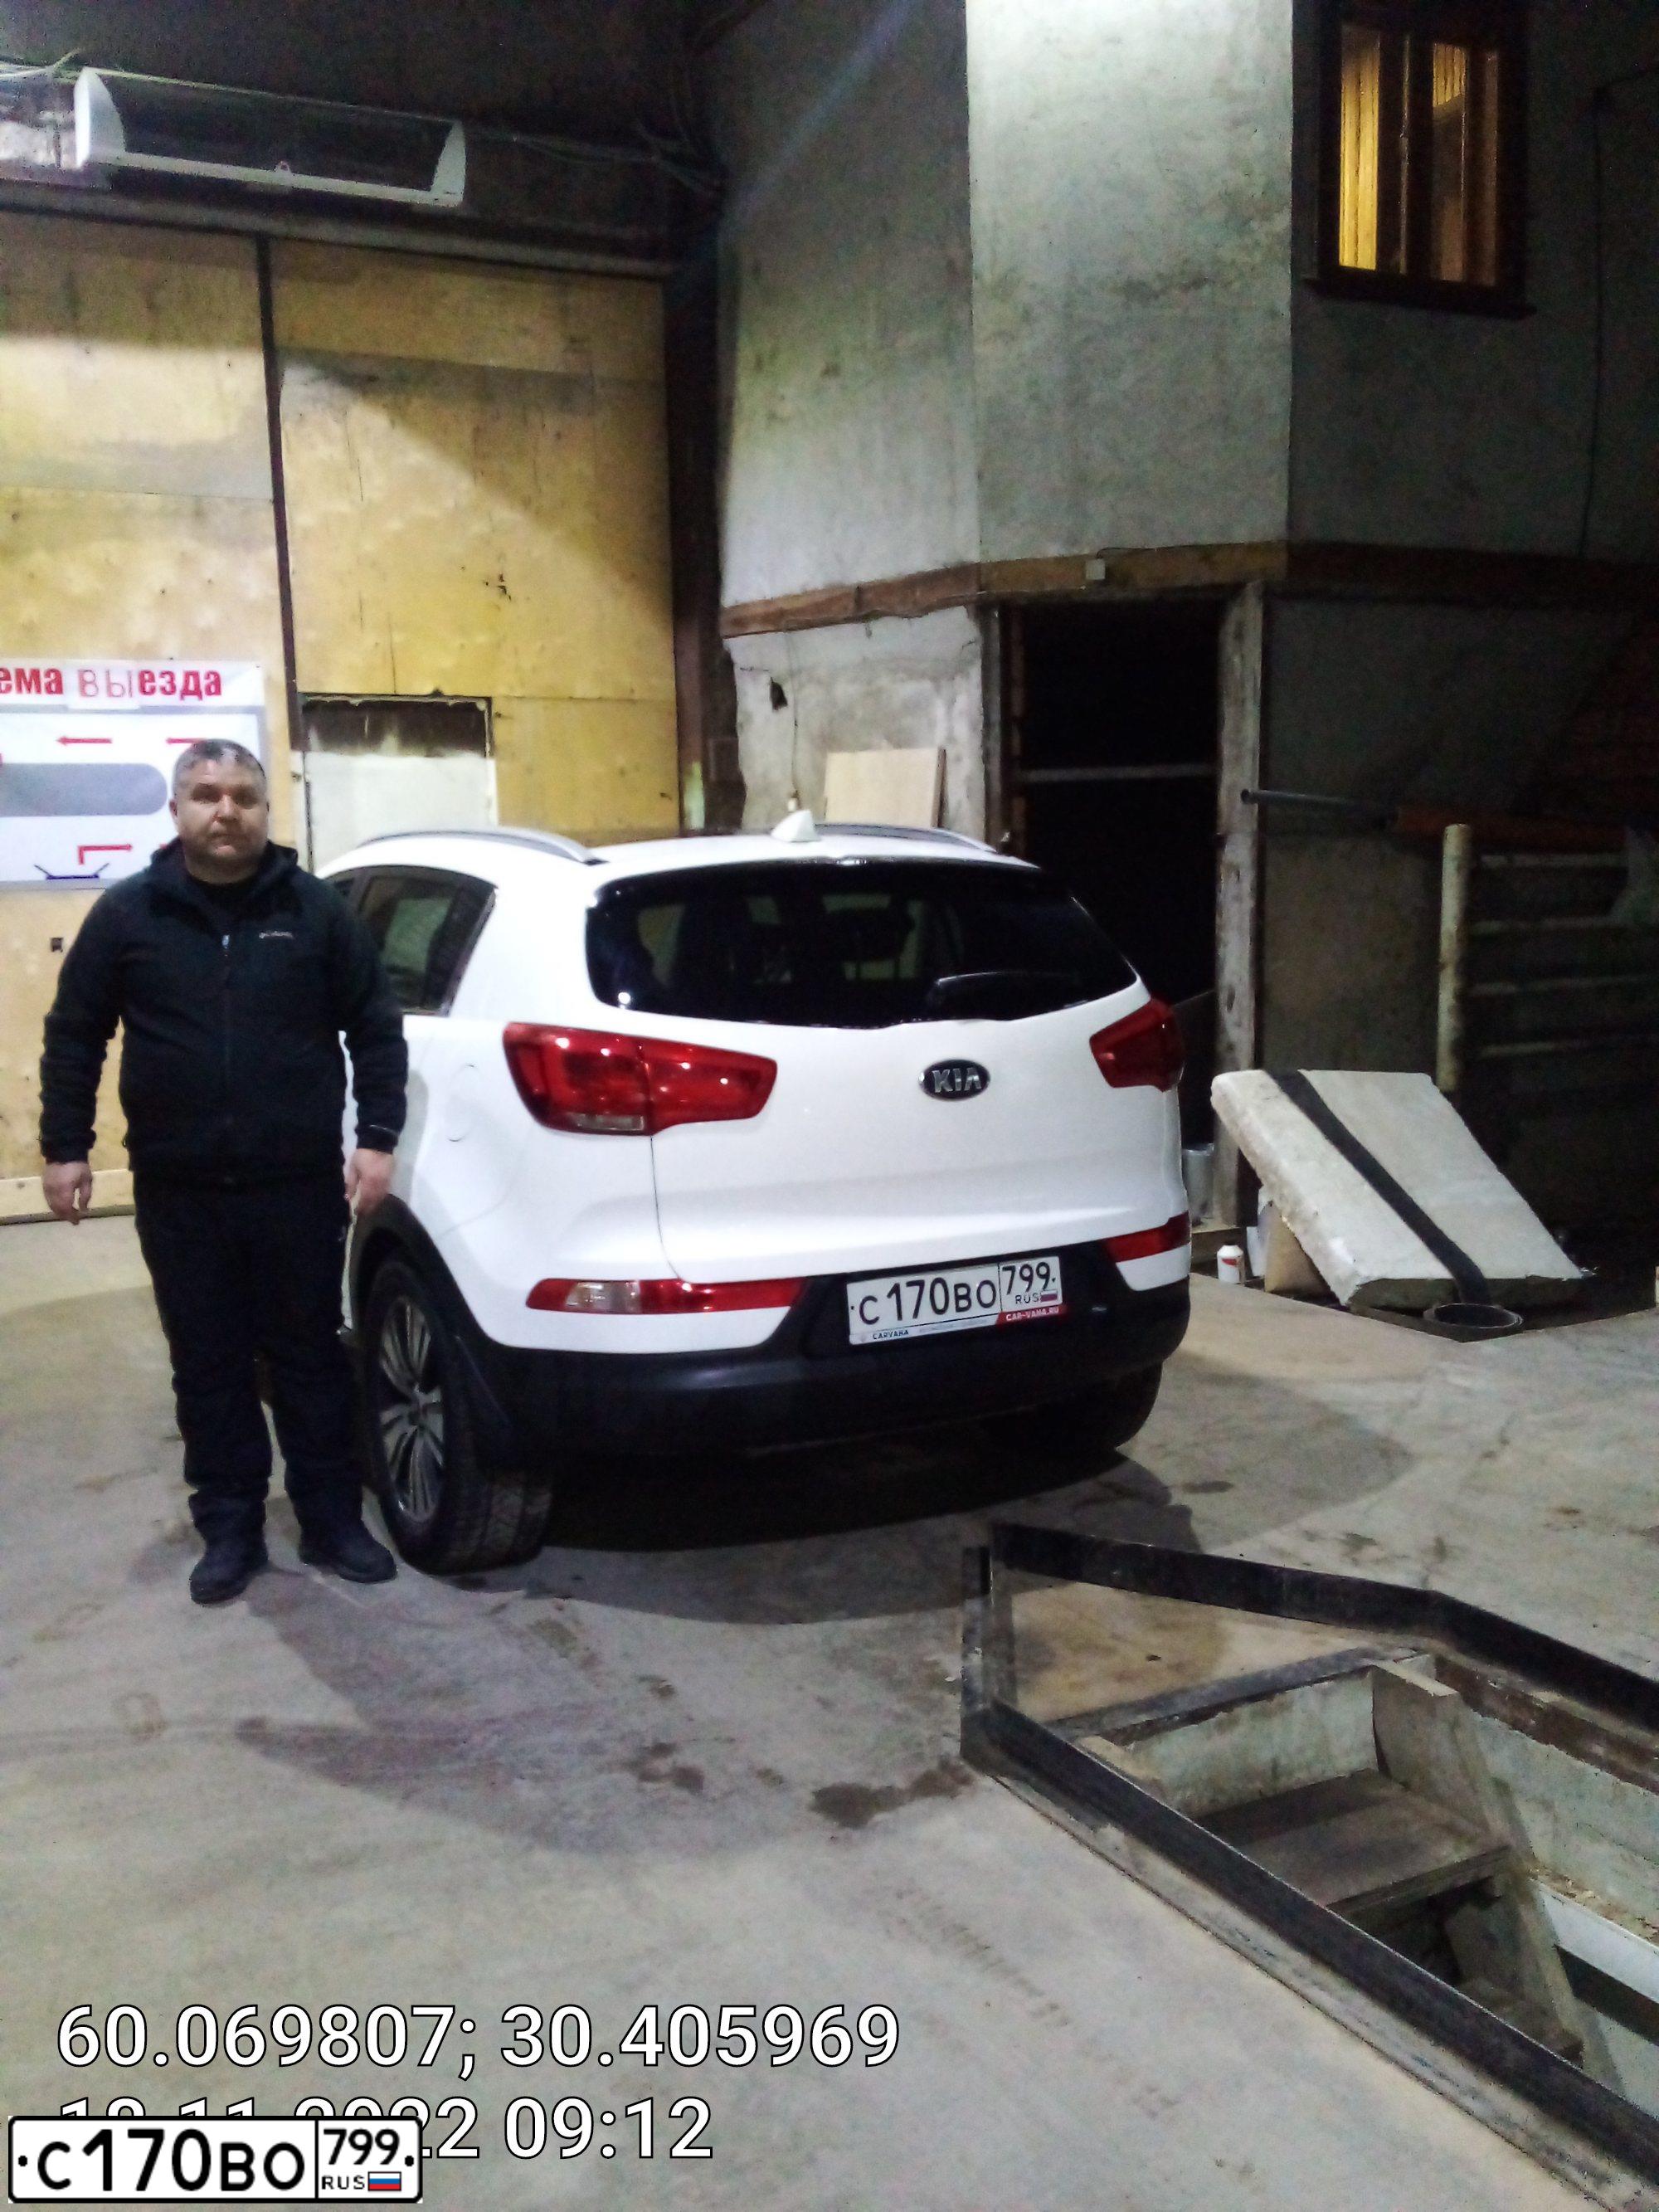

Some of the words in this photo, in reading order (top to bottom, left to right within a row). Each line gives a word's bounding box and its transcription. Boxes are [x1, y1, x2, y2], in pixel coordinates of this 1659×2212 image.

[932, 1067, 982, 1093] KIA
[1002, 1262, 1051, 1294] 799
[1015, 1293, 1040, 1304] RUS
